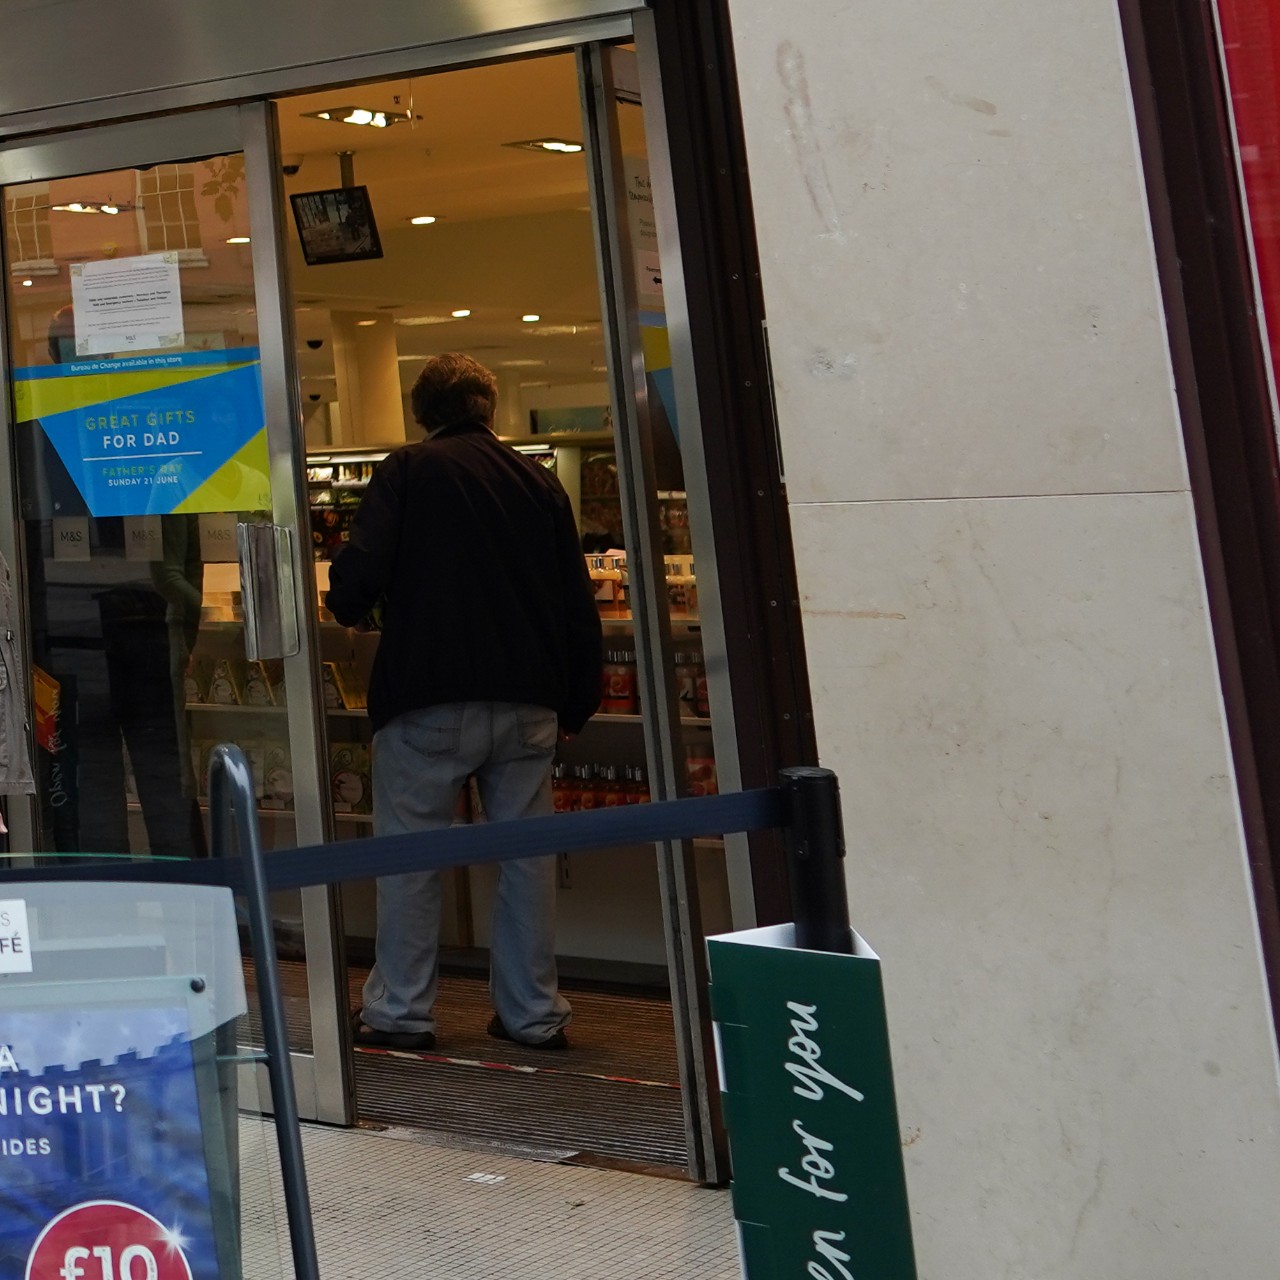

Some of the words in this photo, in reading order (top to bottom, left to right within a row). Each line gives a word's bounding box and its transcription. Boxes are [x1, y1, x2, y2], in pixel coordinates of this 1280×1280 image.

[71, 363, 90, 372] Bureau
[100, 361, 121, 370] Change
[122, 359, 148, 367] available
[85, 415, 138, 431] GREAT
[146, 411, 195, 426] GIFTS
[103, 434, 136, 449] FOR
[144, 432, 180, 446] DAD
[103, 466, 155, 477] FATHER'S
[161, 464, 183, 474] DAY
[108, 478, 141, 487] SUNDAY
[143, 477, 154, 485] 21
[156, 476, 178, 484] JUNE
[60, 530, 82, 542] M&S
[131, 529, 155, 541] M&S
[207, 529, 231, 540] M&S
[784, 1001, 865, 1102] you
[778, 1119, 848, 1202] for
[60, 1245, 159, 1280] £10
